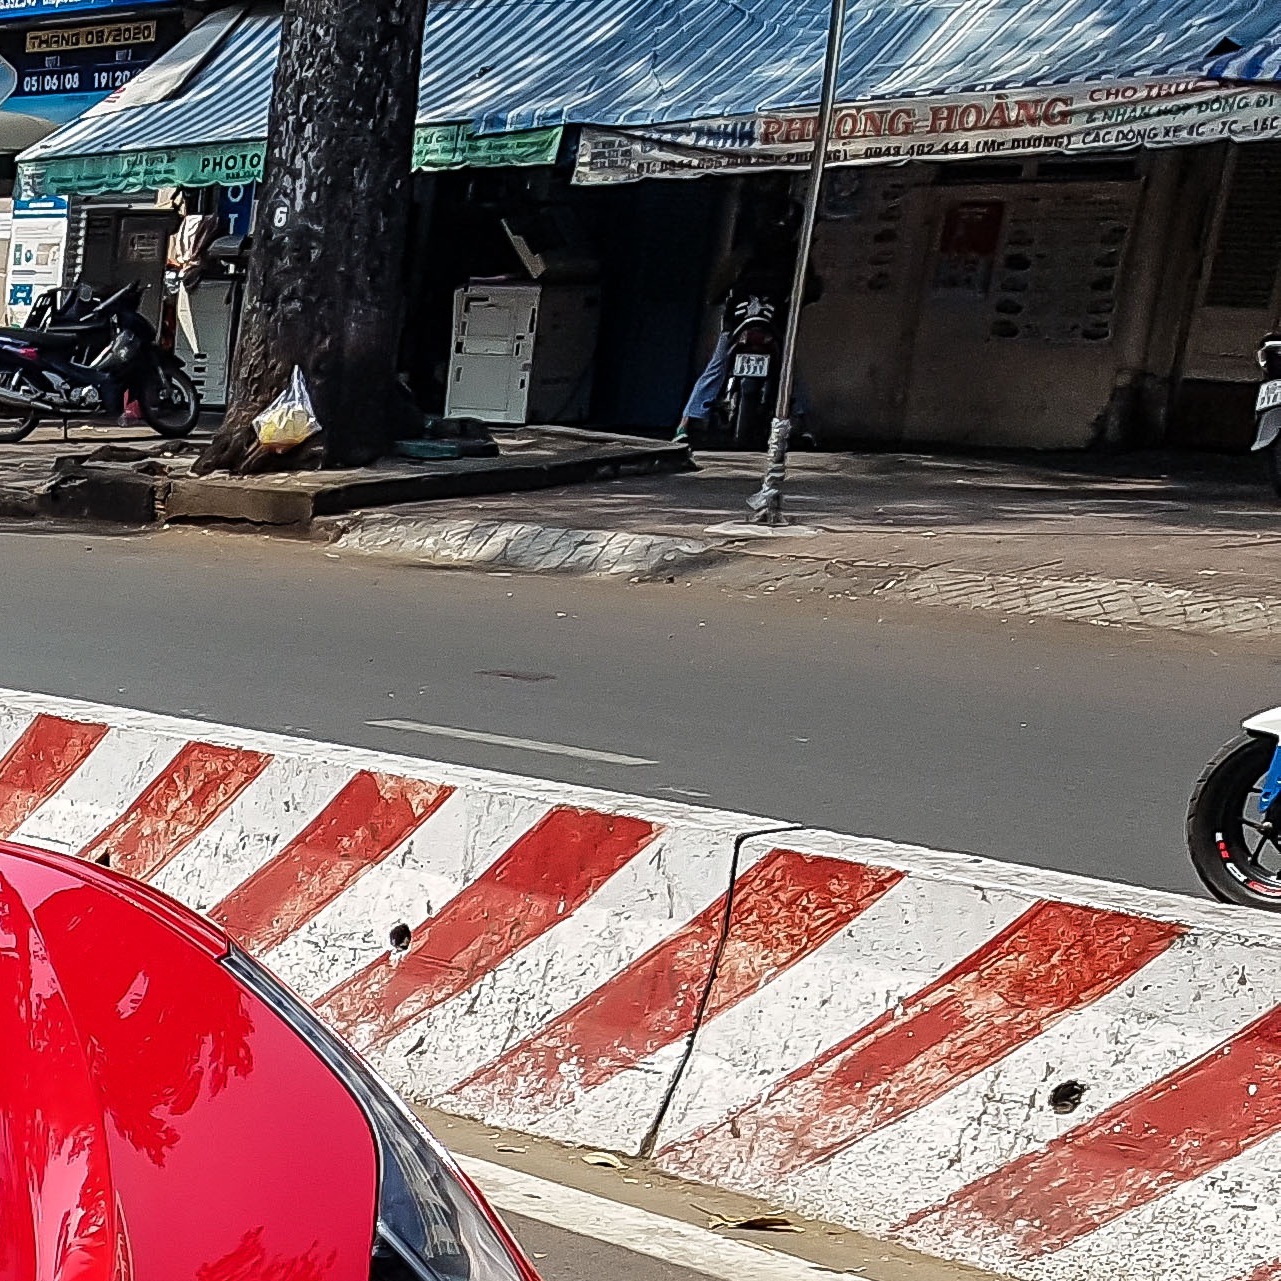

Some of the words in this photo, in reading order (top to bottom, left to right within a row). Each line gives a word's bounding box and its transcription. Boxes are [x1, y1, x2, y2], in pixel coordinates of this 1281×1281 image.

[1089, 86, 1138, 103] CHO
[926, 93, 1074, 134] HOÀNG
[201, 152, 261, 174] PHOTO
